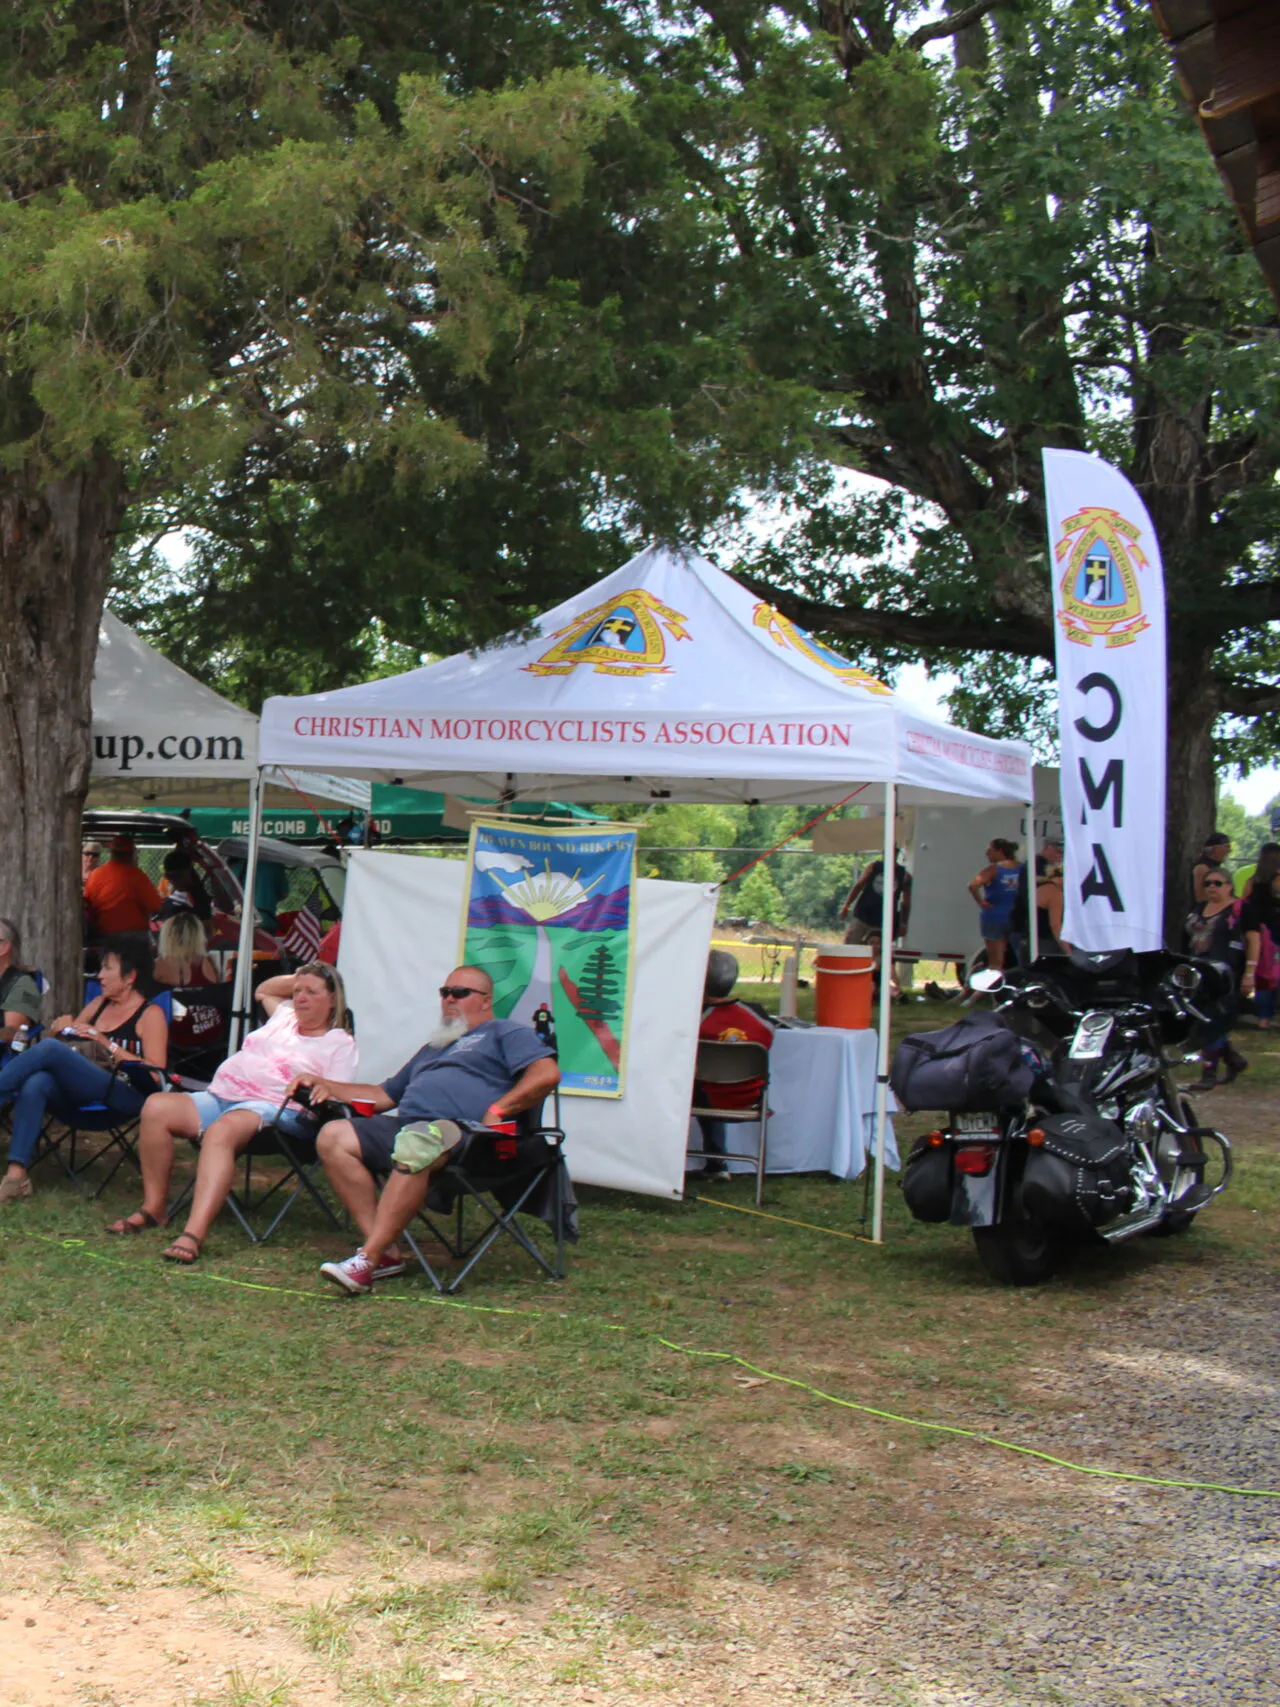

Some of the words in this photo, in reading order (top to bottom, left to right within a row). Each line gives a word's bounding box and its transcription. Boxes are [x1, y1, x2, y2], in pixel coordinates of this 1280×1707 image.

[294, 716, 423, 739] CHRISTIAN
[429, 718, 646, 743] MOTORCYCLISTS
[653, 721, 852, 747] ASSOCIATION
[232, 820, 307, 835] NECOMB
[529, 840, 576, 853] BOUND
[579, 839, 633, 853] BIKERS
